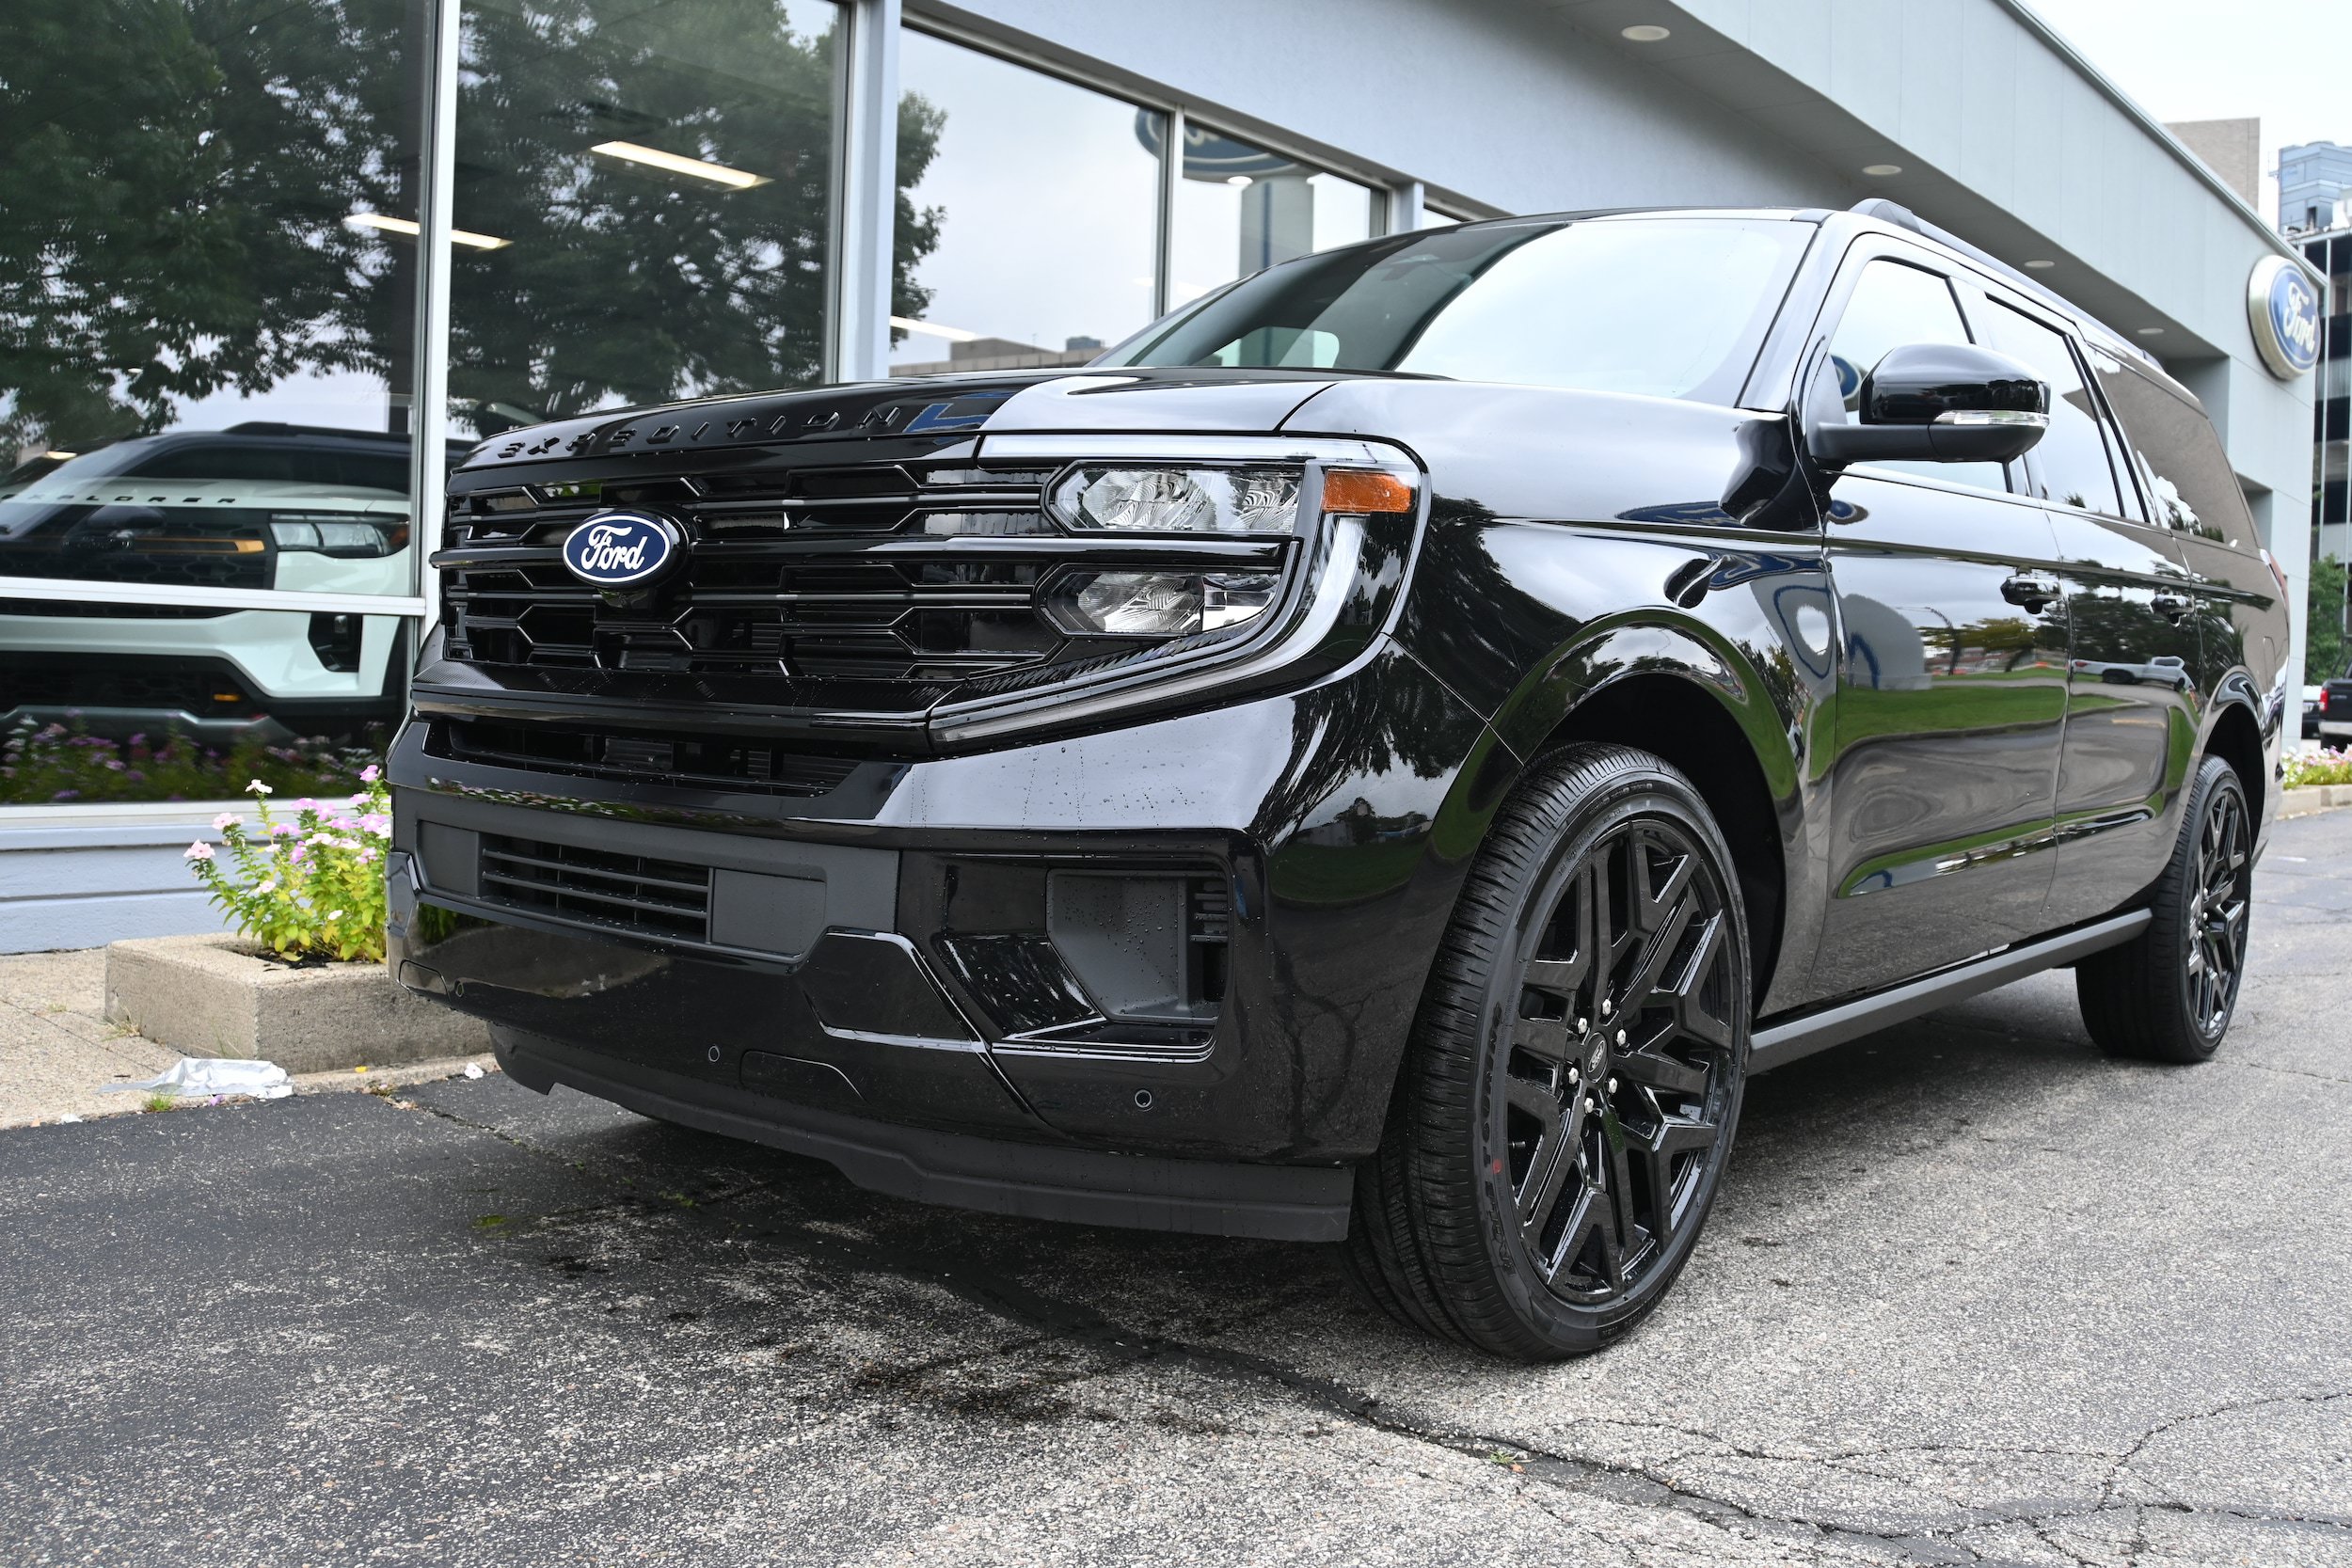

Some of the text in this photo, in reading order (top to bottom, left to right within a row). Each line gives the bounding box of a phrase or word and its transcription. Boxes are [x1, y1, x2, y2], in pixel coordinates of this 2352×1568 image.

[2284, 283, 2315, 353] Ford
[498, 405, 901, 459] EXPEDITION
[1, 493, 236, 503] EXPLORER
[580, 525, 648, 572] Ford
